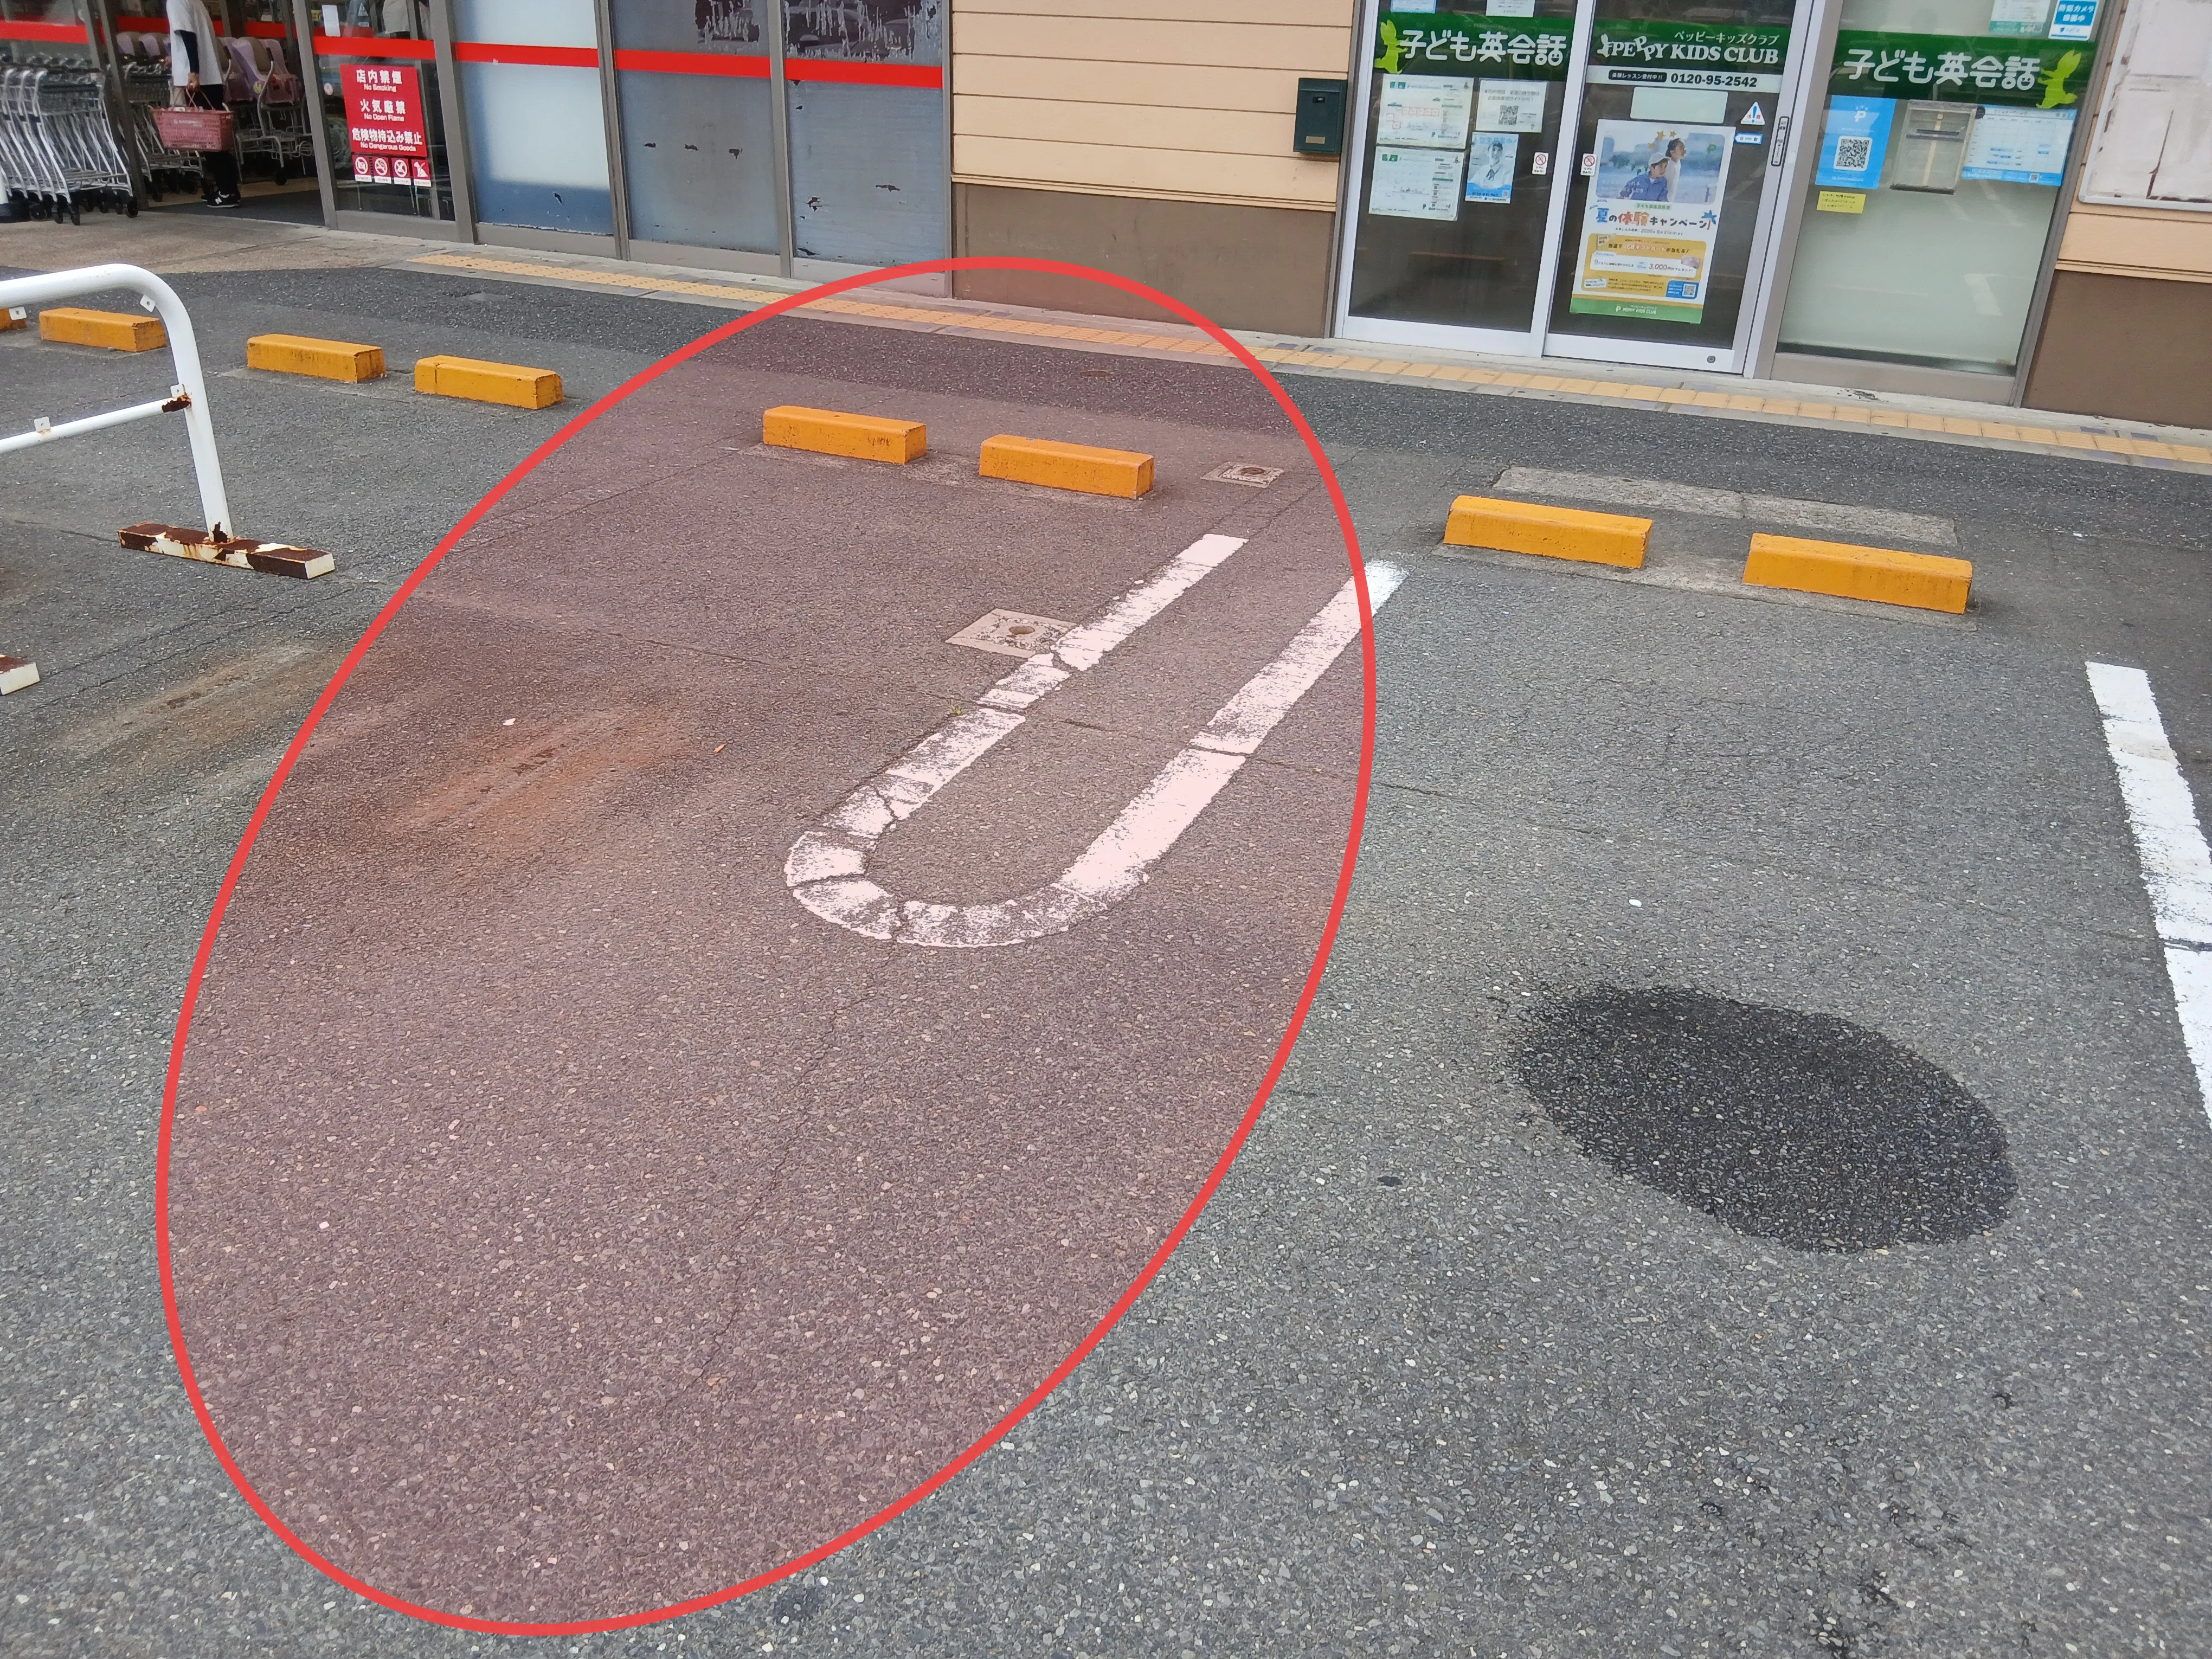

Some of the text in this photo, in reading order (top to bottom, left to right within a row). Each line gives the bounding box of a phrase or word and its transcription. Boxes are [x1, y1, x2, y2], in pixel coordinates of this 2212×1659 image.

[1674, 31, 1780, 46] ペッピーキッズクラブ
[1399, 30, 1567, 66] 子ども英会話
[1611, 36, 1778, 63] PEPPY KIDS CLUB
[356, 69, 402, 84] 店内禁煙
[1844, 49, 2040, 91] 子ども英会話
[1671, 73, 1758, 87] 0120-95-2542
[373, 84, 396, 92] Smoking
[360, 99, 406, 114] 火気厳禁
[352, 127, 422, 145] 危険物持込み禁止
